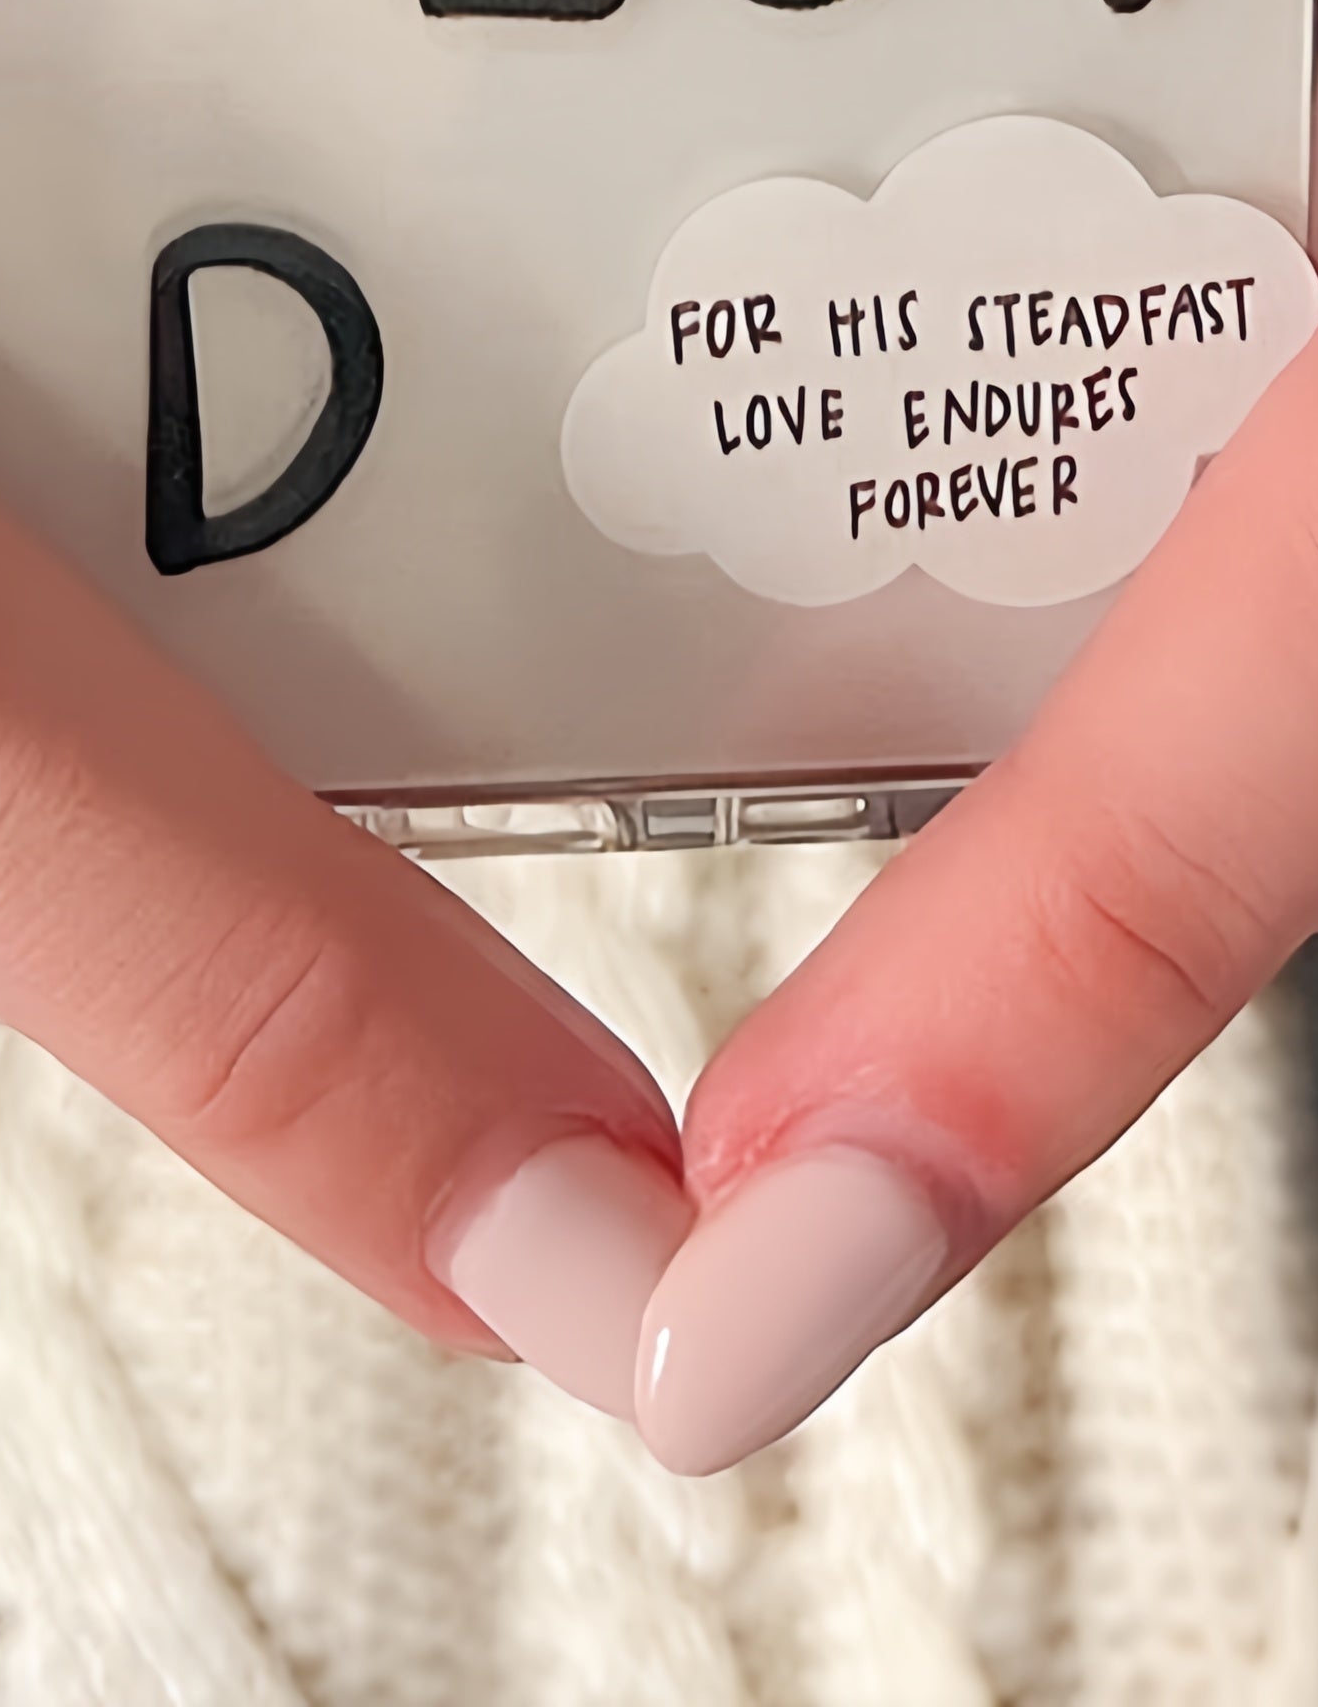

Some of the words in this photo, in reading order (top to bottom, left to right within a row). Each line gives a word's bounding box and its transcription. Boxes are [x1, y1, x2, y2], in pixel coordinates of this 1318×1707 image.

[669, 293, 783, 367] FOR
[827, 288, 919, 359] HIS
[967, 276, 1256, 359] STEADFAST
[712, 384, 845, 457] LOVE
[902, 364, 1139, 451] ENDURES
[848, 453, 1079, 541] FOREVER
